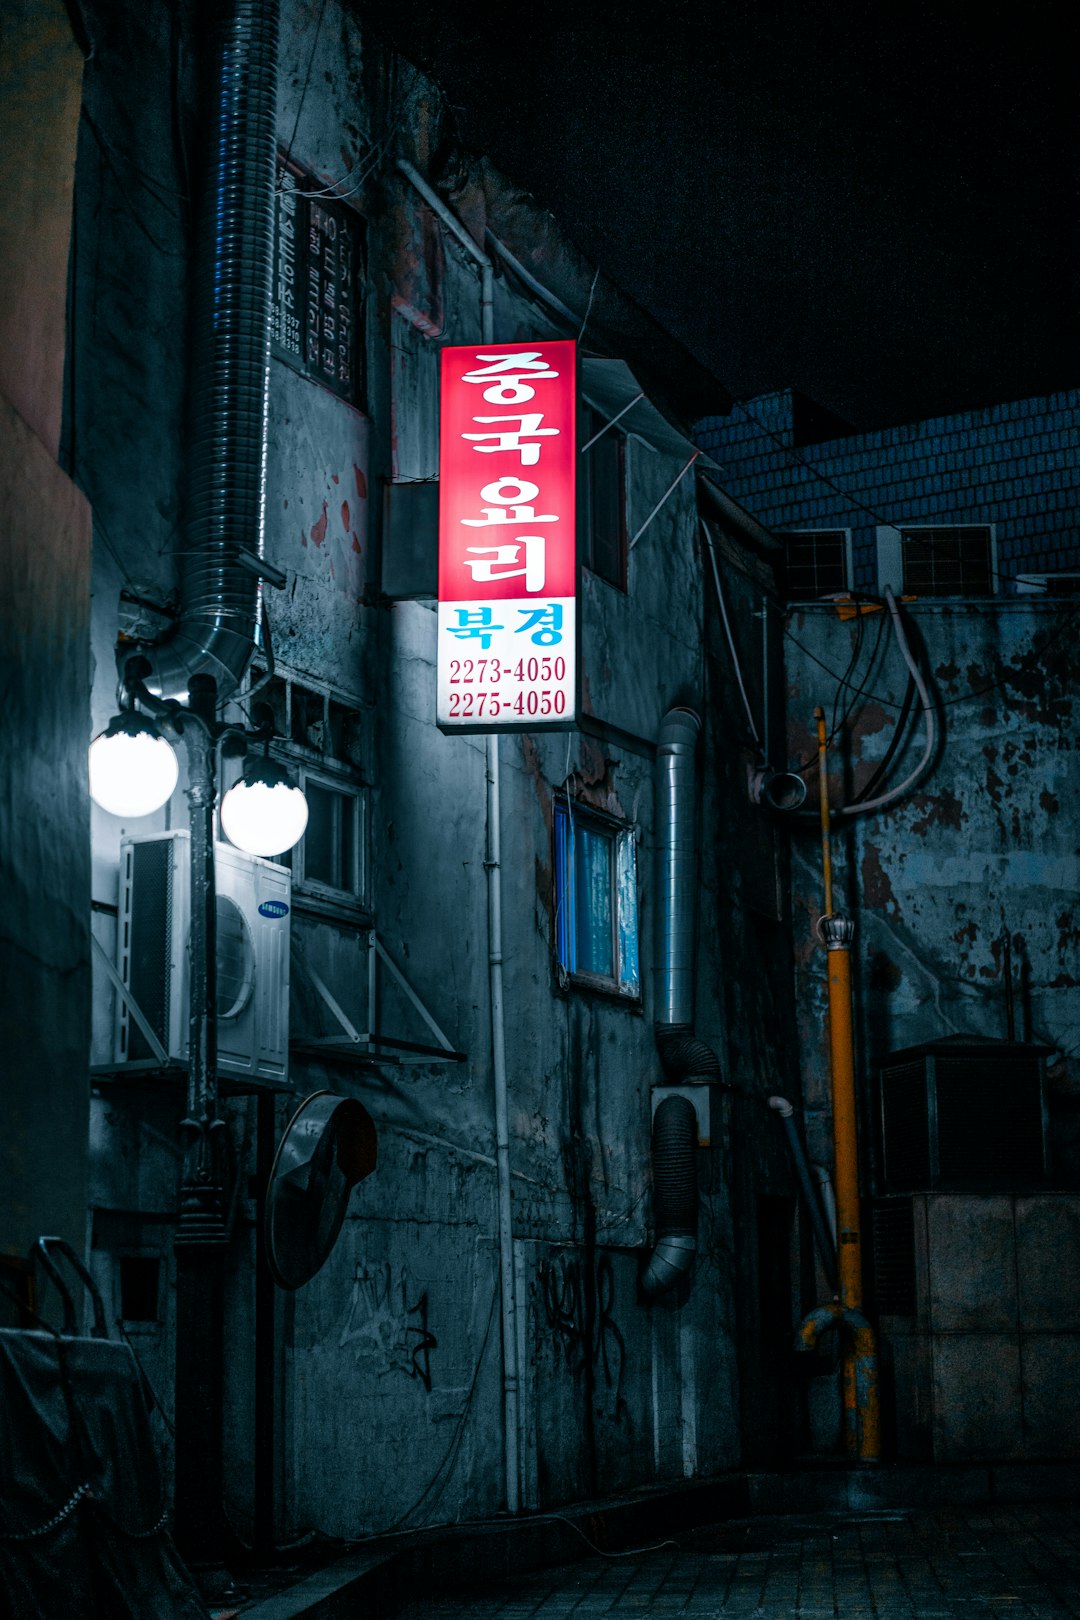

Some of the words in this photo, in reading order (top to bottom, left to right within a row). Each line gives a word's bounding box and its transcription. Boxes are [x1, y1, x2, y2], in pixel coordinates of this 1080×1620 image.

[460, 352, 560, 593] 중국요리
[450, 656, 566, 684] 2273-4050
[449, 690, 566, 717] 2275-4050
